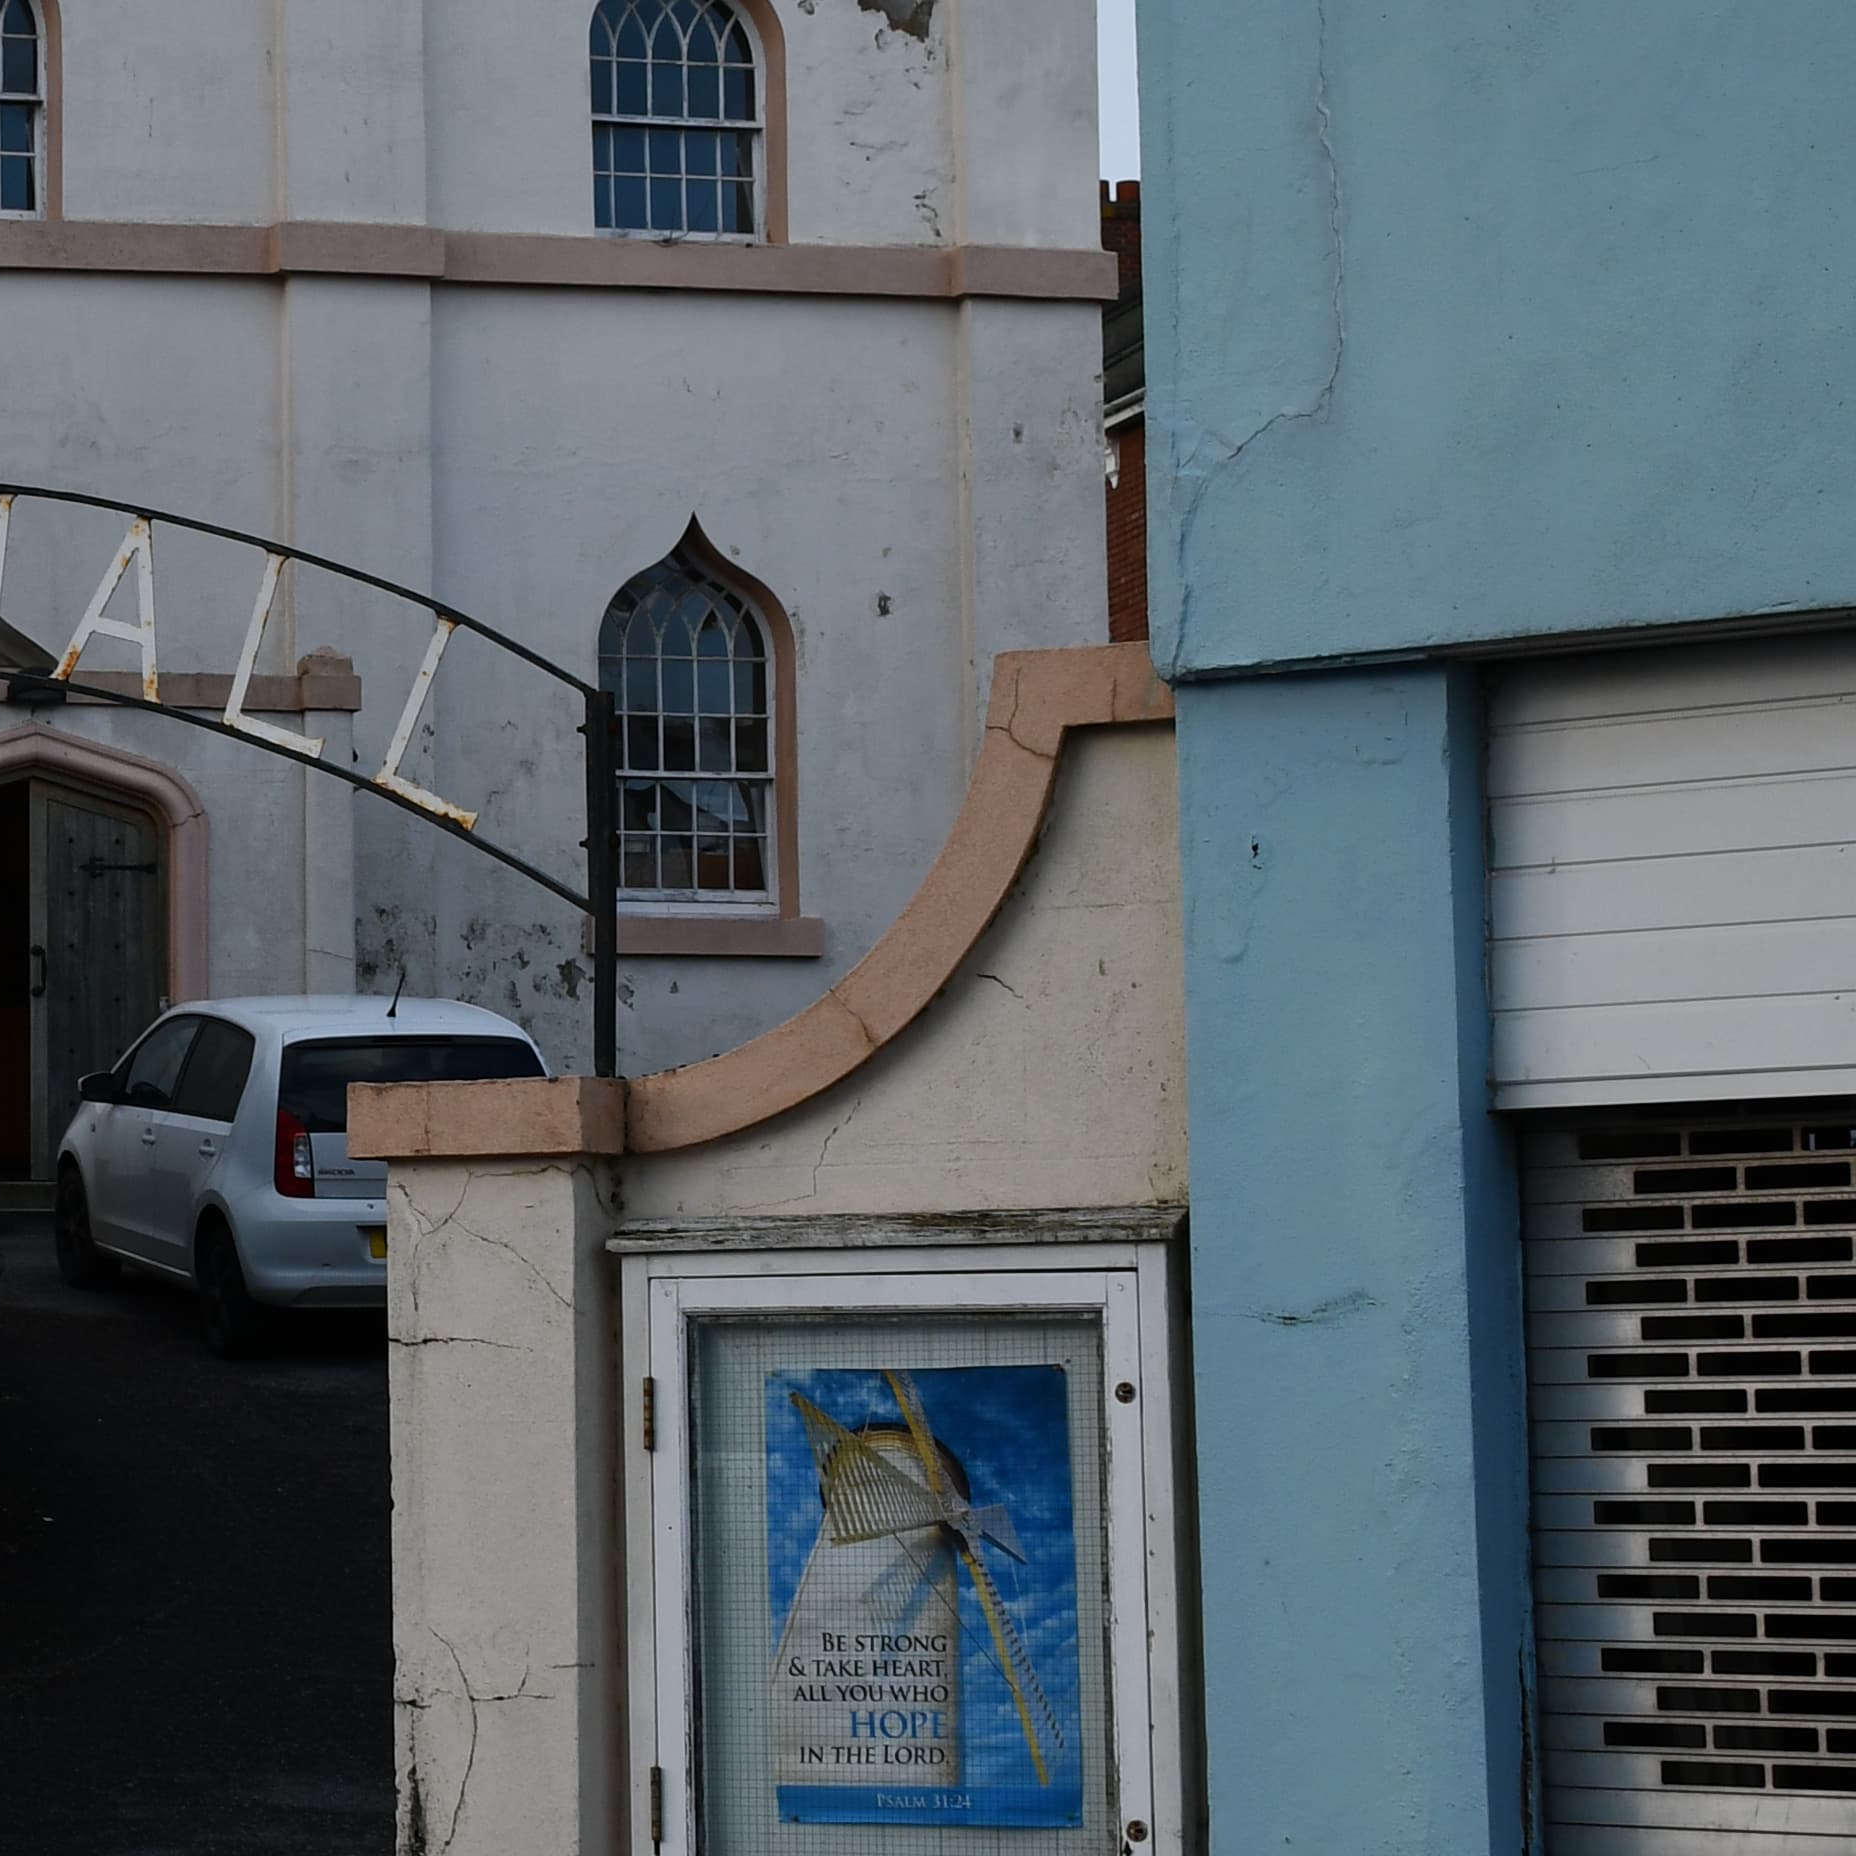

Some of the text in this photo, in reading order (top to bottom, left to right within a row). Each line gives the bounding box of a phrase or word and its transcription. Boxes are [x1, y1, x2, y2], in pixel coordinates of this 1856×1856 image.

[854, 1634, 947, 1652] STRONG
[788, 1656, 948, 1679] & TAKE HEART,
[793, 1685, 948, 1702] ALL YOU WHO
[850, 1710, 949, 1739] HOPE
[800, 1745, 950, 1765] IN THE LORD.
[877, 1793, 971, 1809] PSALM 31:24
